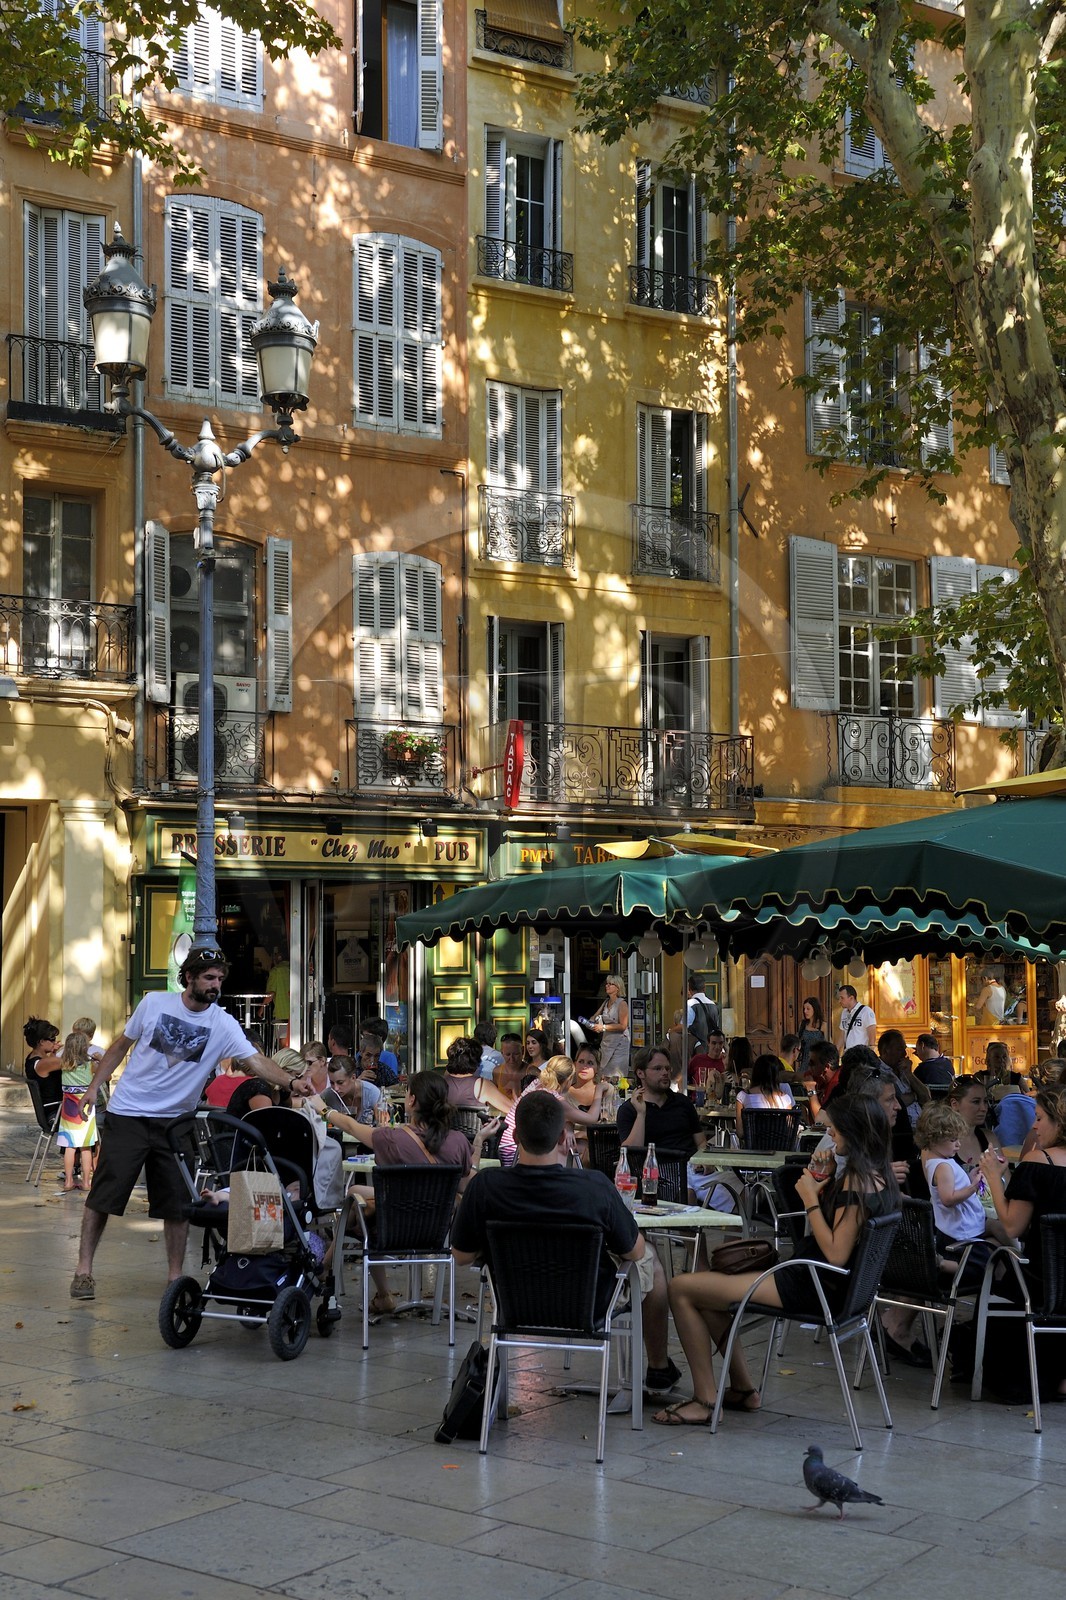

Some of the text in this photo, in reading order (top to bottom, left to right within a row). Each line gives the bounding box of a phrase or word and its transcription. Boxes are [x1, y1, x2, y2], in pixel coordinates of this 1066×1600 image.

[507, 732, 515, 798] TABAC
[171, 833, 286, 857] BRSSERIE
[435, 841, 470, 861] PUB
[520, 845, 620, 864] PMU TABA
